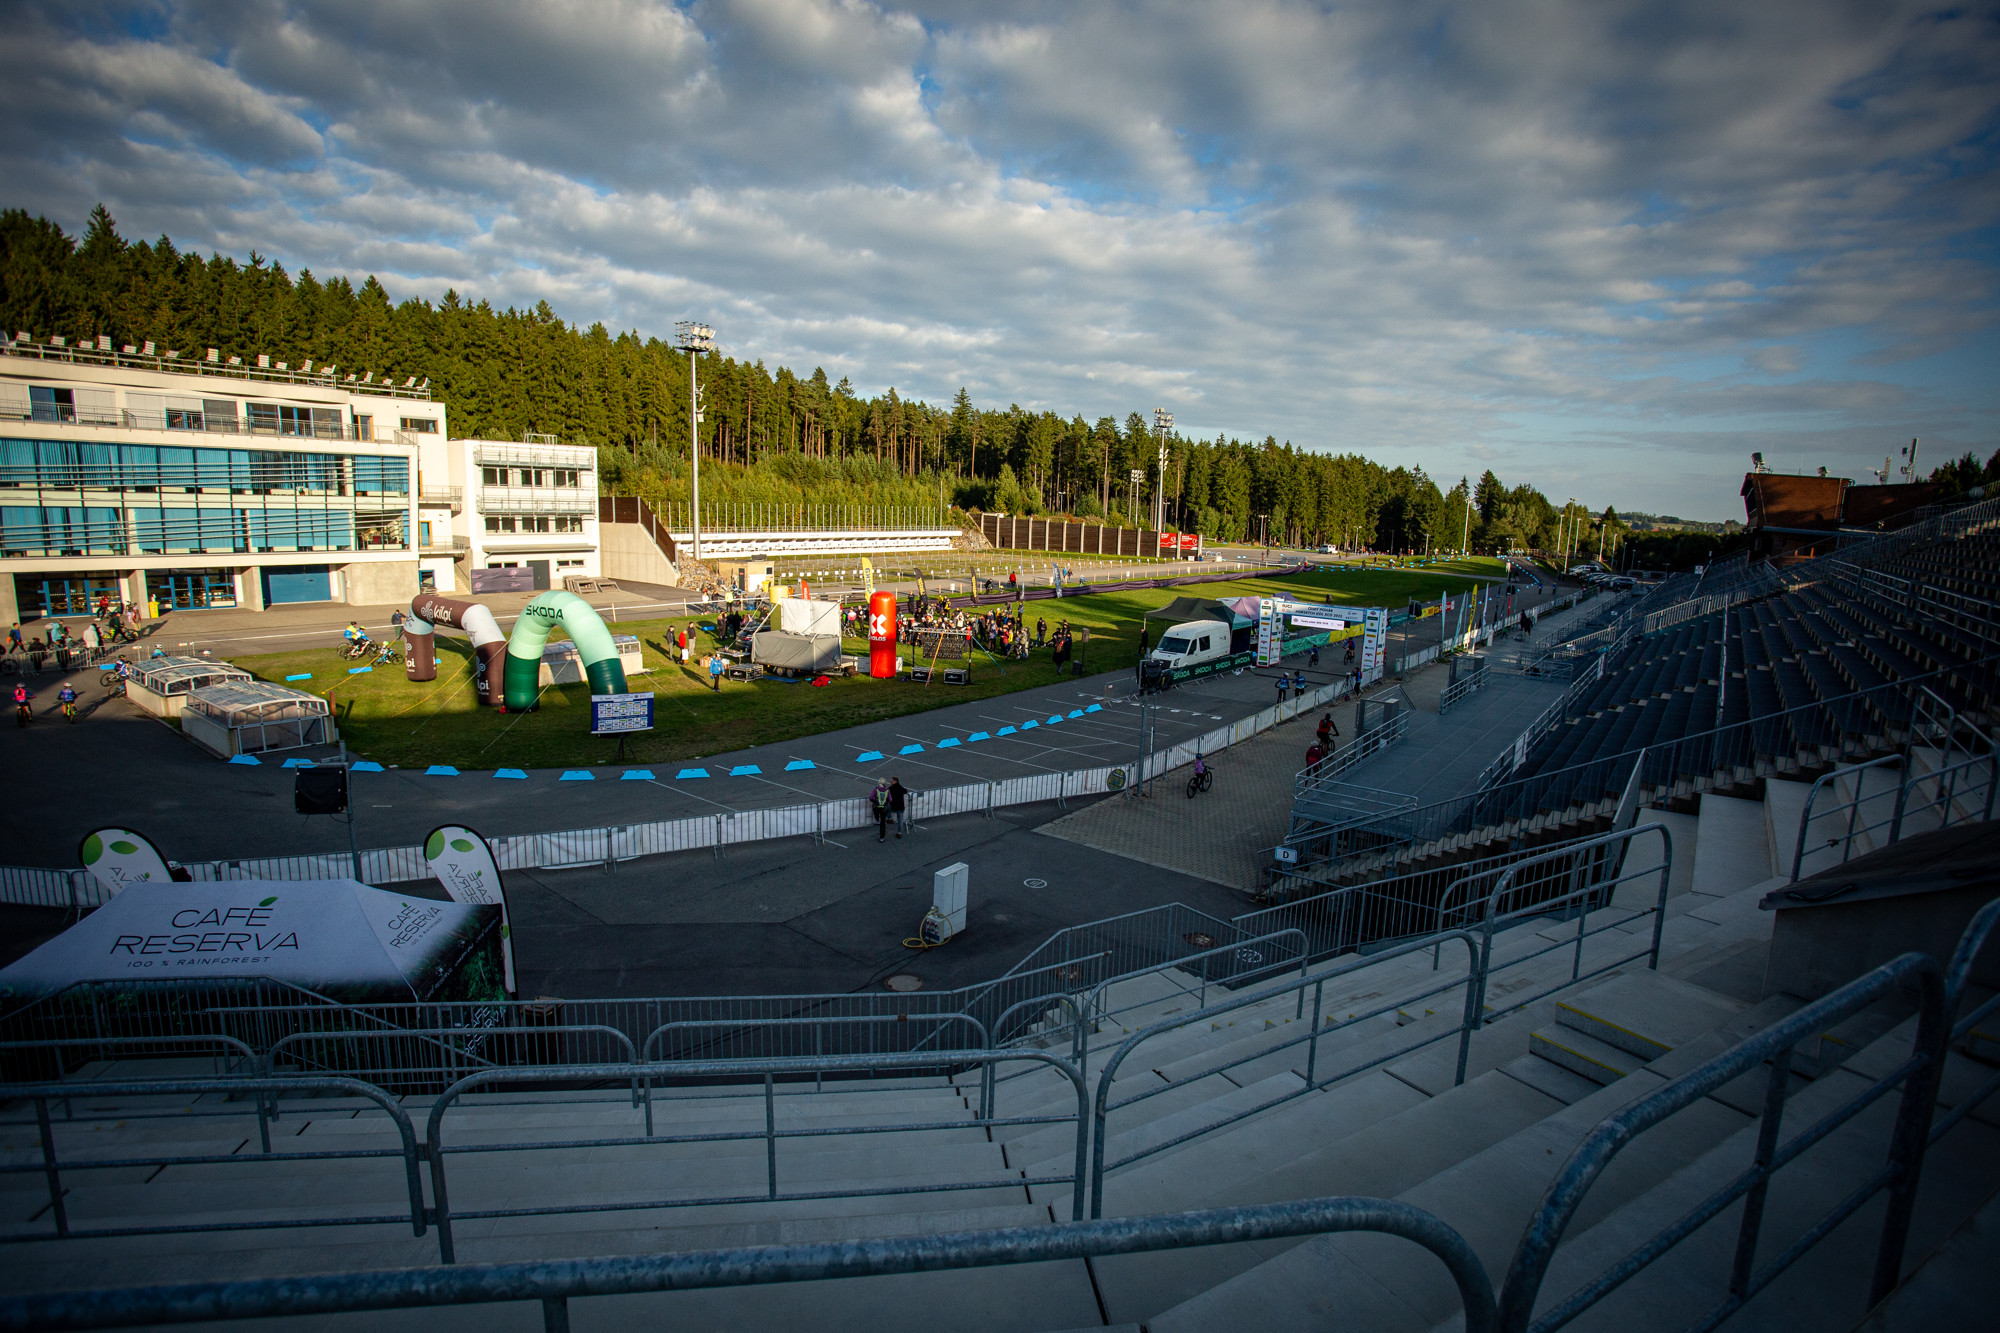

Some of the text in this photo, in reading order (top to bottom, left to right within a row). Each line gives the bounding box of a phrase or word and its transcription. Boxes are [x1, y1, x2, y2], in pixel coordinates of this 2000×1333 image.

[433, 604, 453, 623] kilpi
[1283, 850, 1289, 859] D
[389, 906, 442, 948] RESERVA
[110, 931, 299, 955] RESERVA
[127, 960, 152, 968] 100
[176, 956, 272, 966] RAINFOREST
